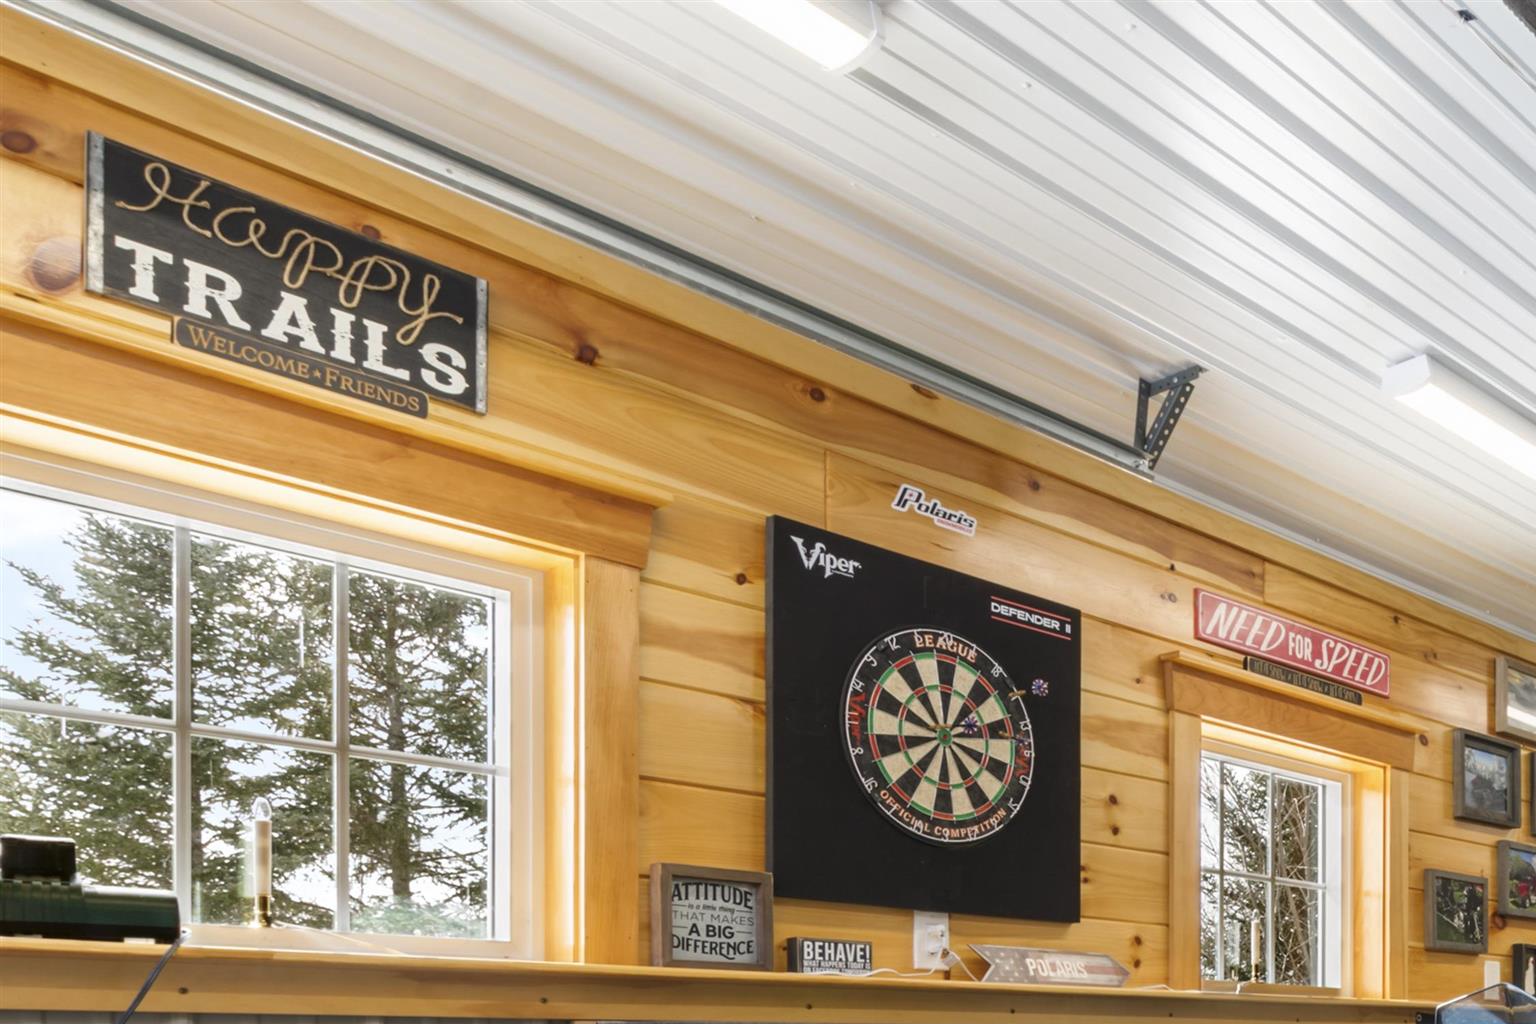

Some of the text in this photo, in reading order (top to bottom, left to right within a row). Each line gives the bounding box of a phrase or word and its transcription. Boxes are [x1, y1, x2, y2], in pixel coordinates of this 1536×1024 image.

[115, 162, 463, 346] Happy
[114, 234, 470, 396] TRAILS
[187, 324, 421, 412] WELCOME FRIENDS
[895, 487, 975, 528] Polaris
[790, 535, 861, 578] Viper
[991, 602, 1060, 631] DEFENDER
[1205, 602, 1385, 686] NEED FOR SPEED
[879, 789, 931, 833] OFFICIAL
[672, 882, 753, 910] ATTITUDE
[673, 910, 754, 927] THAT MAKES
[688, 923, 735, 939] A BIG
[672, 933, 754, 960] DIFFERENCE
[803, 940, 870, 963] BEHAVE!
[1025, 958, 1088, 978] POLARIS
